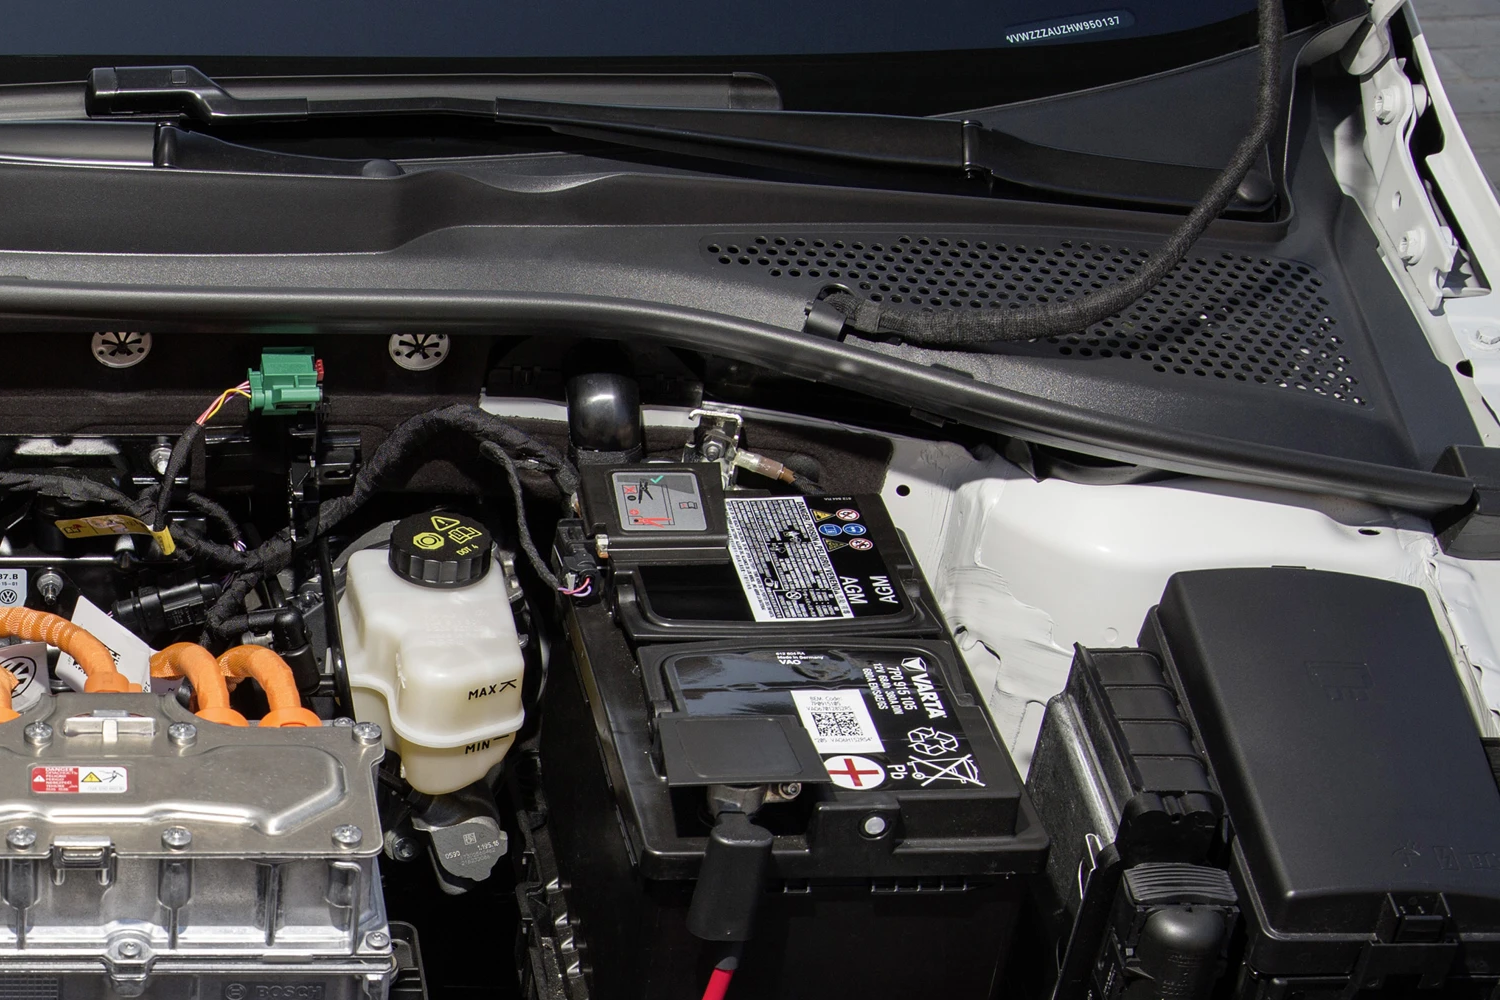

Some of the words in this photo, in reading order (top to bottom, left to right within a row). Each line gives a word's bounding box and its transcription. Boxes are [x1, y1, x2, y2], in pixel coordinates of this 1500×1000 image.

[456, 546, 472, 556] DOT
[839, 576, 868, 605] AGM
[869, 575, 898, 604] AGM
[873, 662, 886, 674] 12V
[468, 684, 497, 700] MAX
[893, 681, 911, 696] 915
[911, 673, 946, 719] VARTA
[900, 696, 918, 711] 105
[465, 740, 490, 755] MIN
[887, 764, 908, 780] Pb
[256, 985, 322, 999] BOSCH
